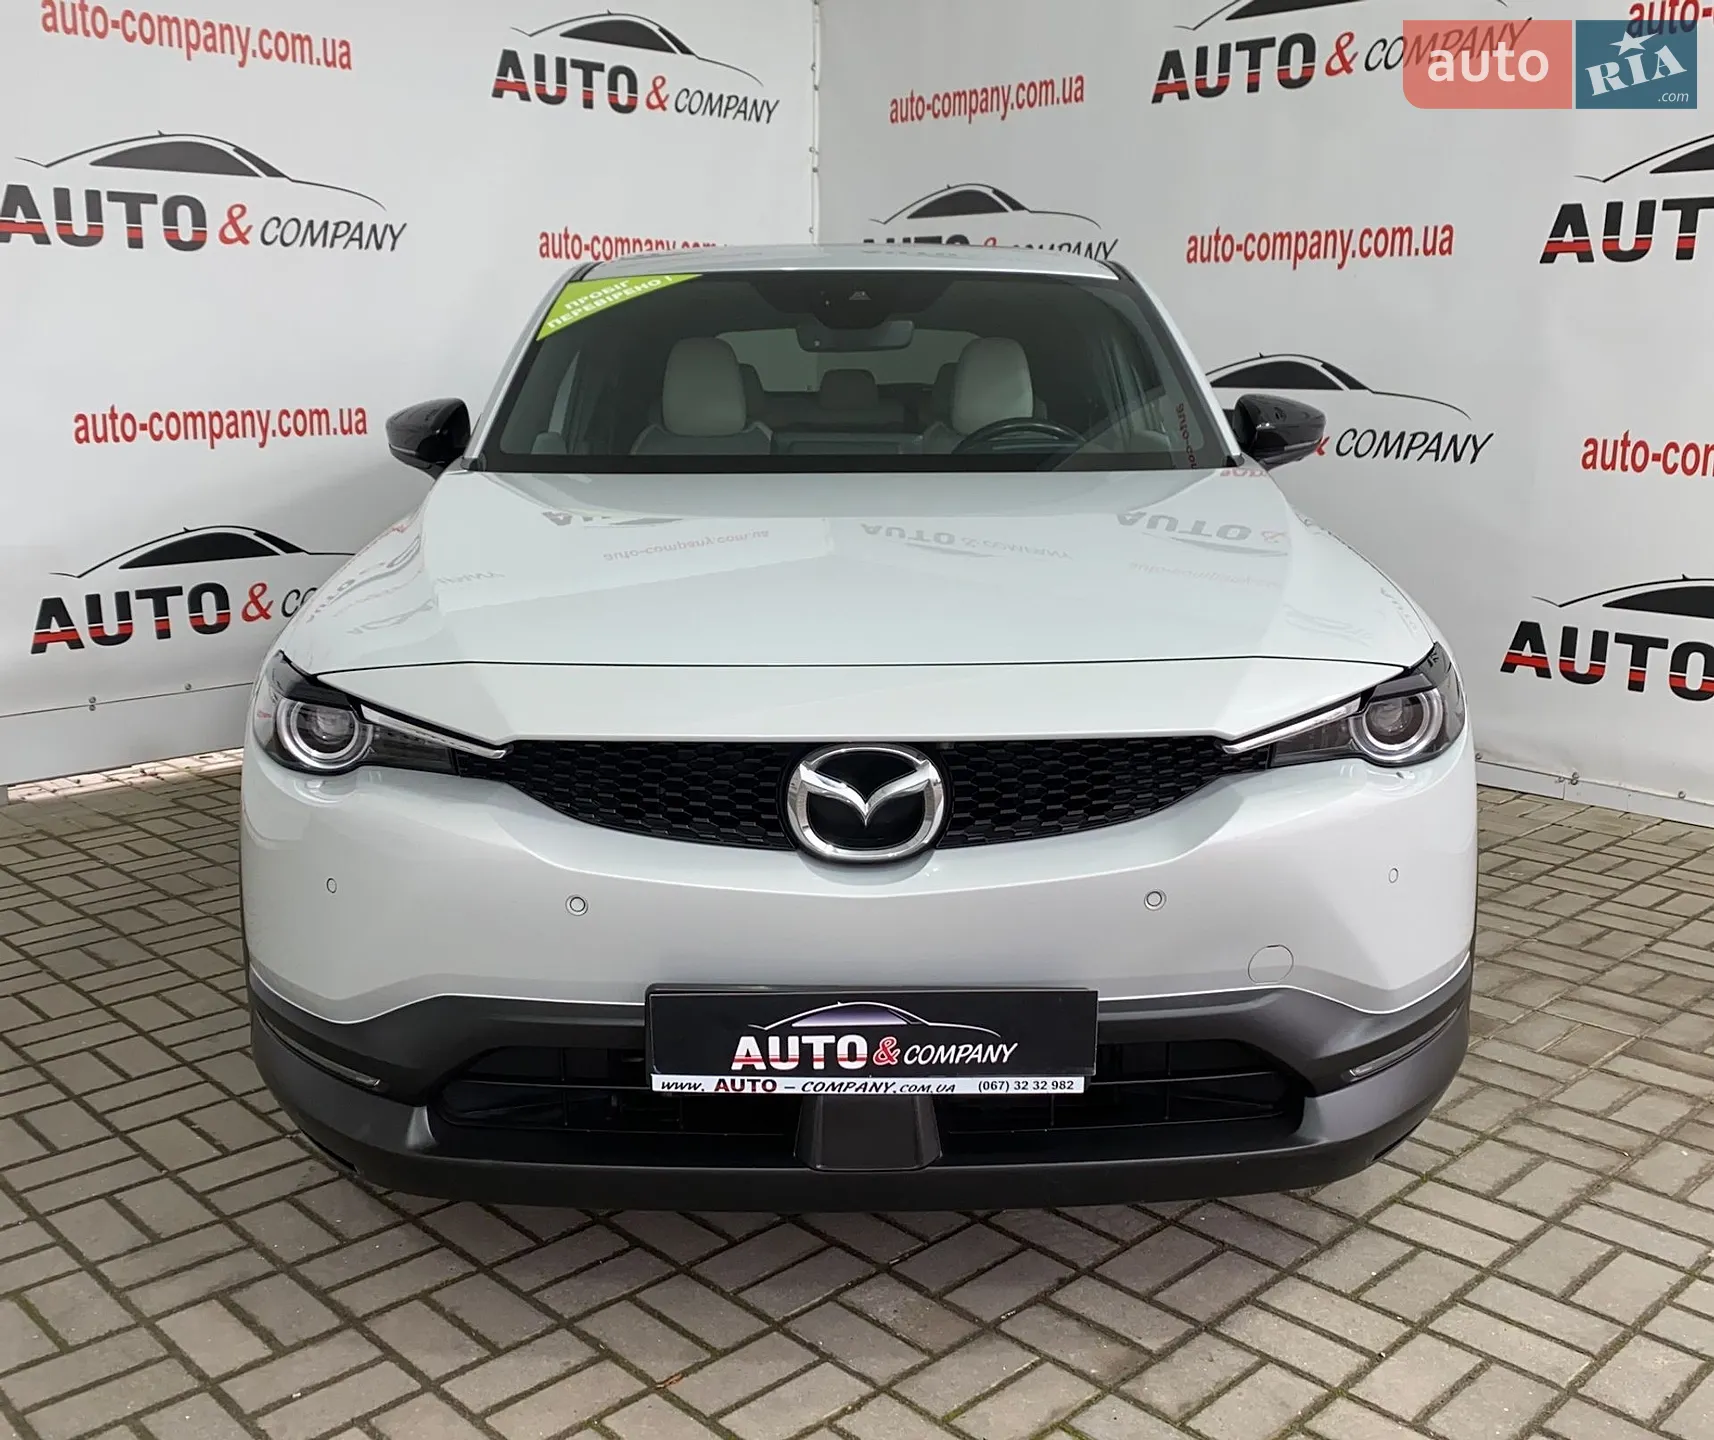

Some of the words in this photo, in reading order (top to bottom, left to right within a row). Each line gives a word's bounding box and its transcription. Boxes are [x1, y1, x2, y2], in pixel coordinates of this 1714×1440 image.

[41, 0, 352, 70] auto-company.com.ua
[1626, 0, 1714, 39] auto-
[491, 48, 639, 114] AUTO
[645, 75, 670, 112] &
[674, 87, 780, 125] COMPANY
[1151, 32, 1317, 104] AUTO
[1324, 31, 1358, 77] &
[889, 74, 1085, 124] auto-company.com.ua
[0, 184, 207, 252] AUTO
[218, 203, 253, 246] &
[260, 216, 408, 252] COMPANY
[1539, 196, 1714, 264] AUT
[1186, 223, 1454, 271] auto-company.com.ua
[547, 279, 662, 328] ПЕРЕВІРЕНО
[564, 279, 631, 310] ПРОБІГ
[73, 404, 368, 449] auto-company.com.ua
[1335, 428, 1494, 465] COMPANY
[30, 582, 231, 654] AUTO
[241, 582, 274, 622] &
[1500, 620, 1714, 702] AUTO
[730, 1035, 867, 1071] AUTO
[872, 1036, 901, 1067] &
[904, 1043, 1018, 1066] COMPANY
[714, 1078, 777, 1092] AUTO
[978, 1080, 1010, 1092] (067)
[1013, 1080, 1028, 1091] 32
[1032, 1080, 1047, 1091] 32
[1051, 1080, 1074, 1091] 982
